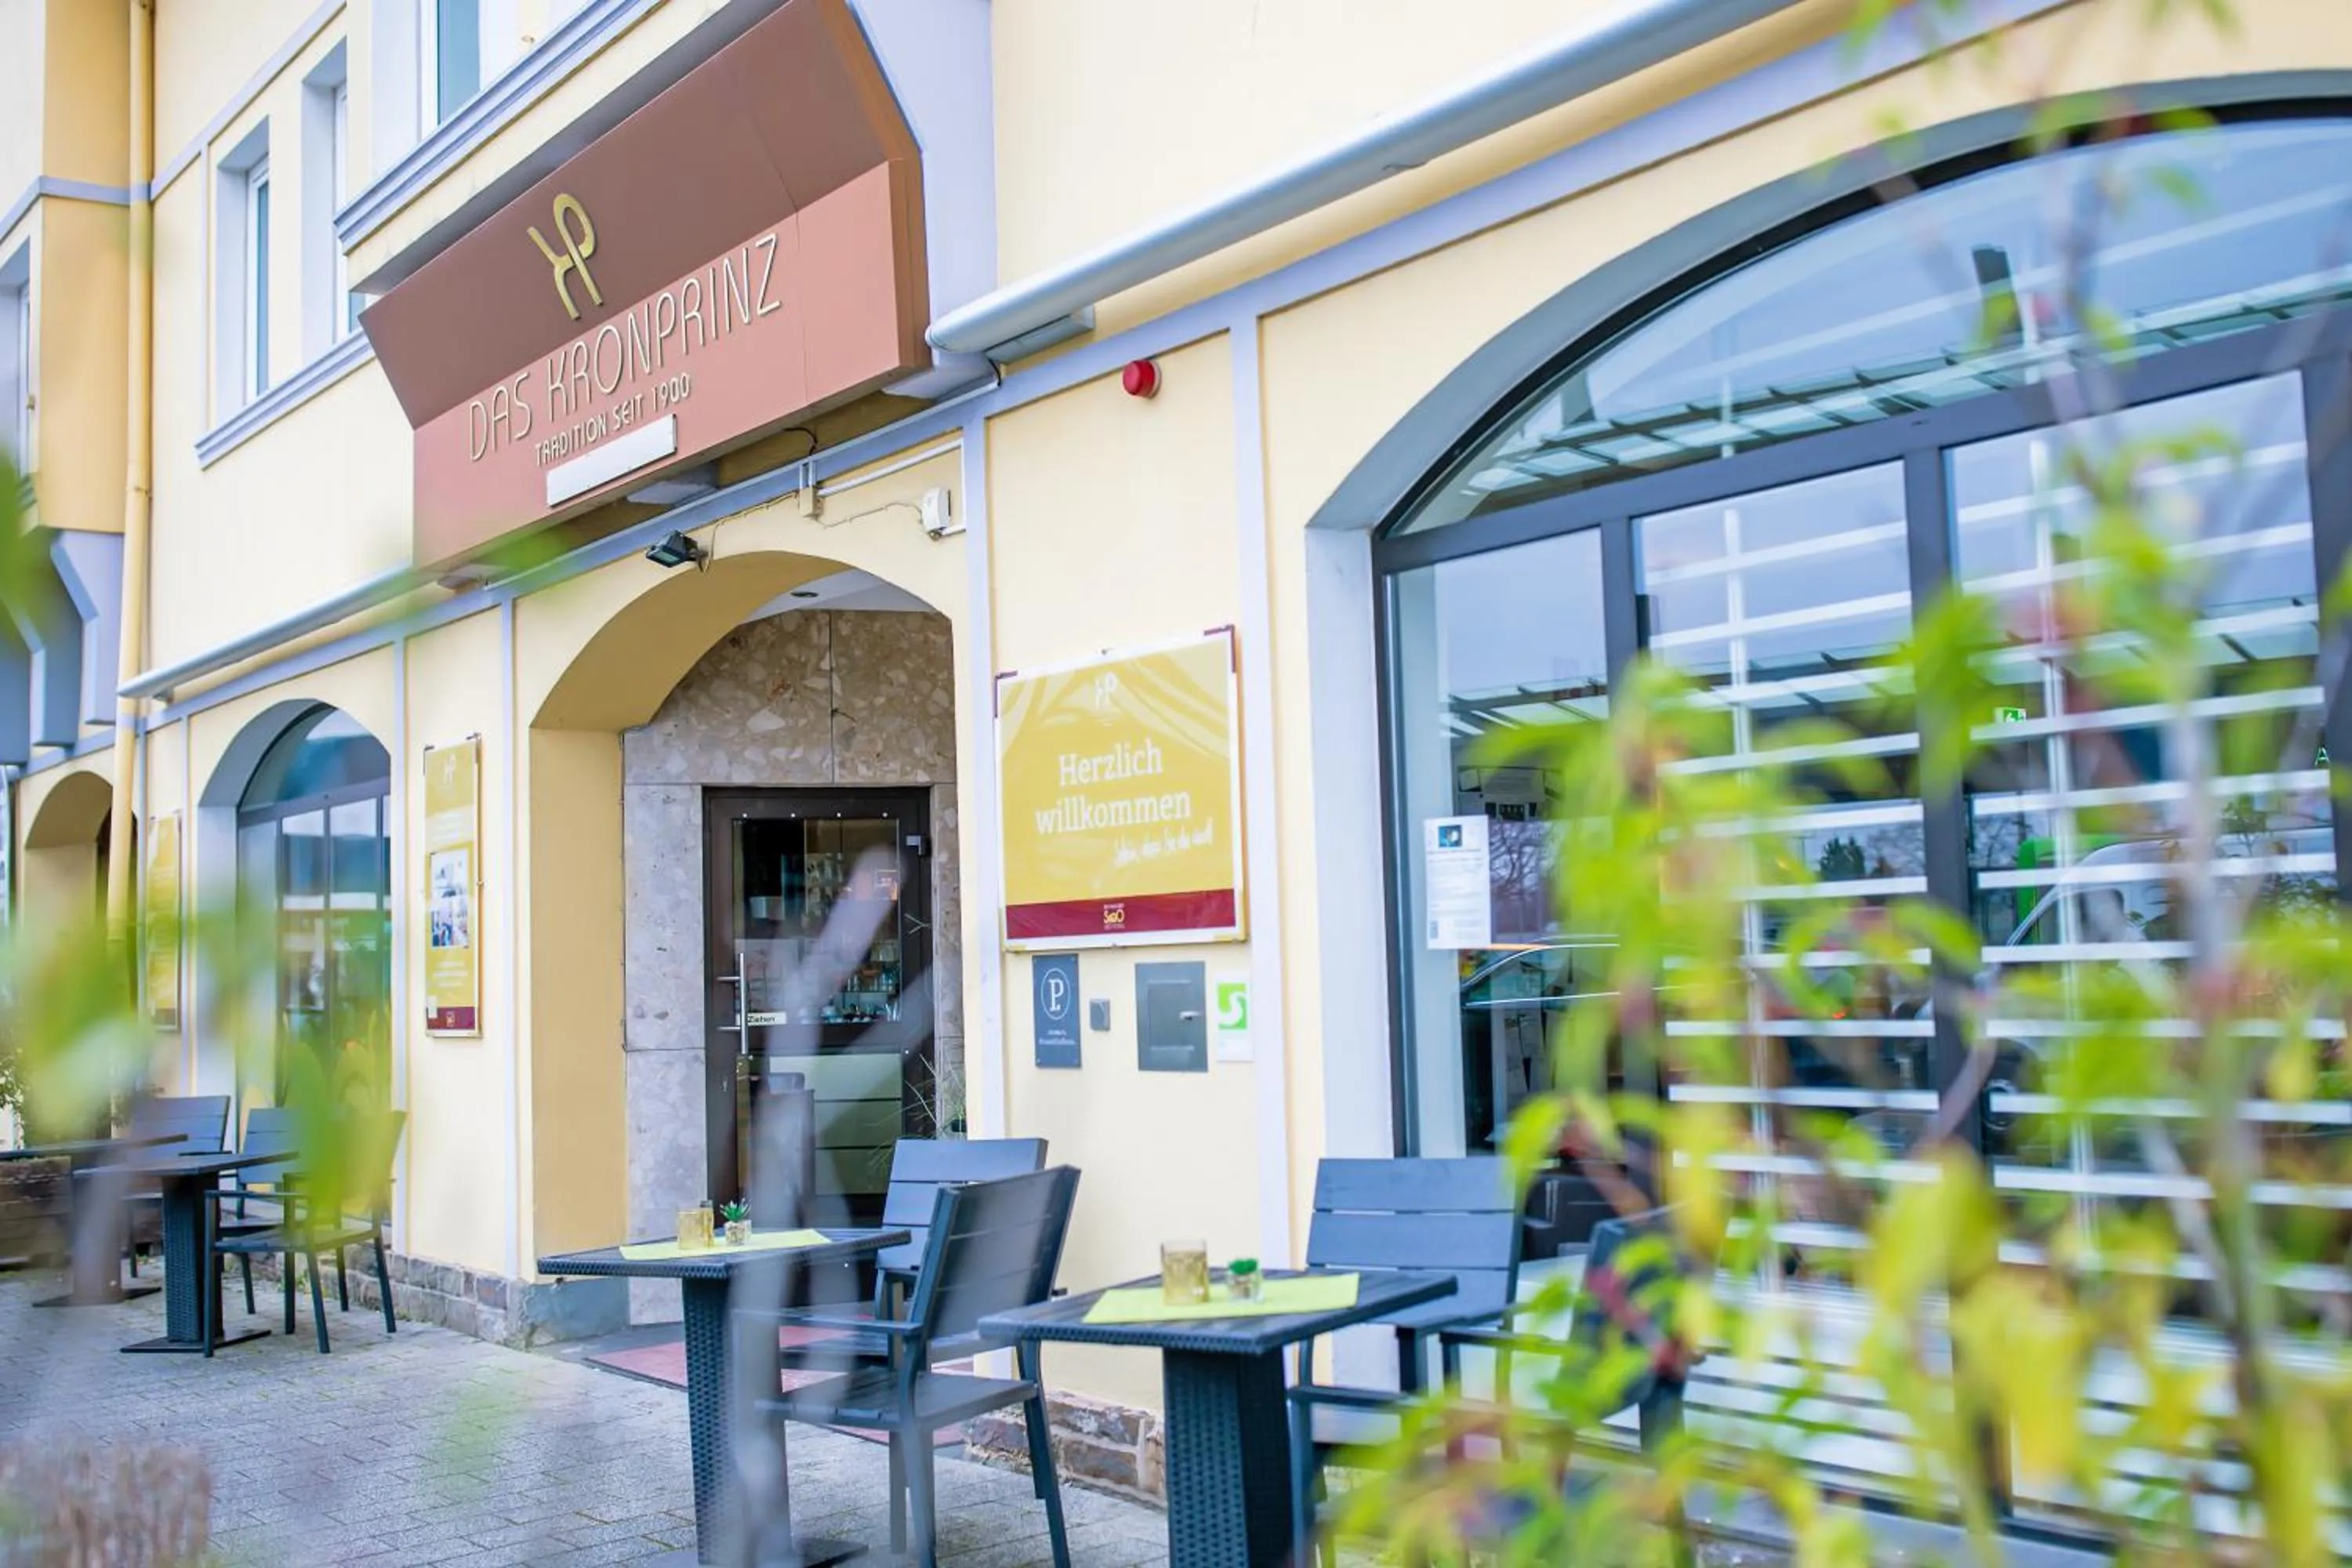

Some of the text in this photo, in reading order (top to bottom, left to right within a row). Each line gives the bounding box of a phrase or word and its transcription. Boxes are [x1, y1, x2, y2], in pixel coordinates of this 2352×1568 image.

[470, 233, 781, 461] DAS KRONPRINZ
[535, 372, 691, 467] TRADITION SEIT 1900
[1058, 737, 1163, 787] Herzlich
[1035, 790, 1192, 835] willkommen
